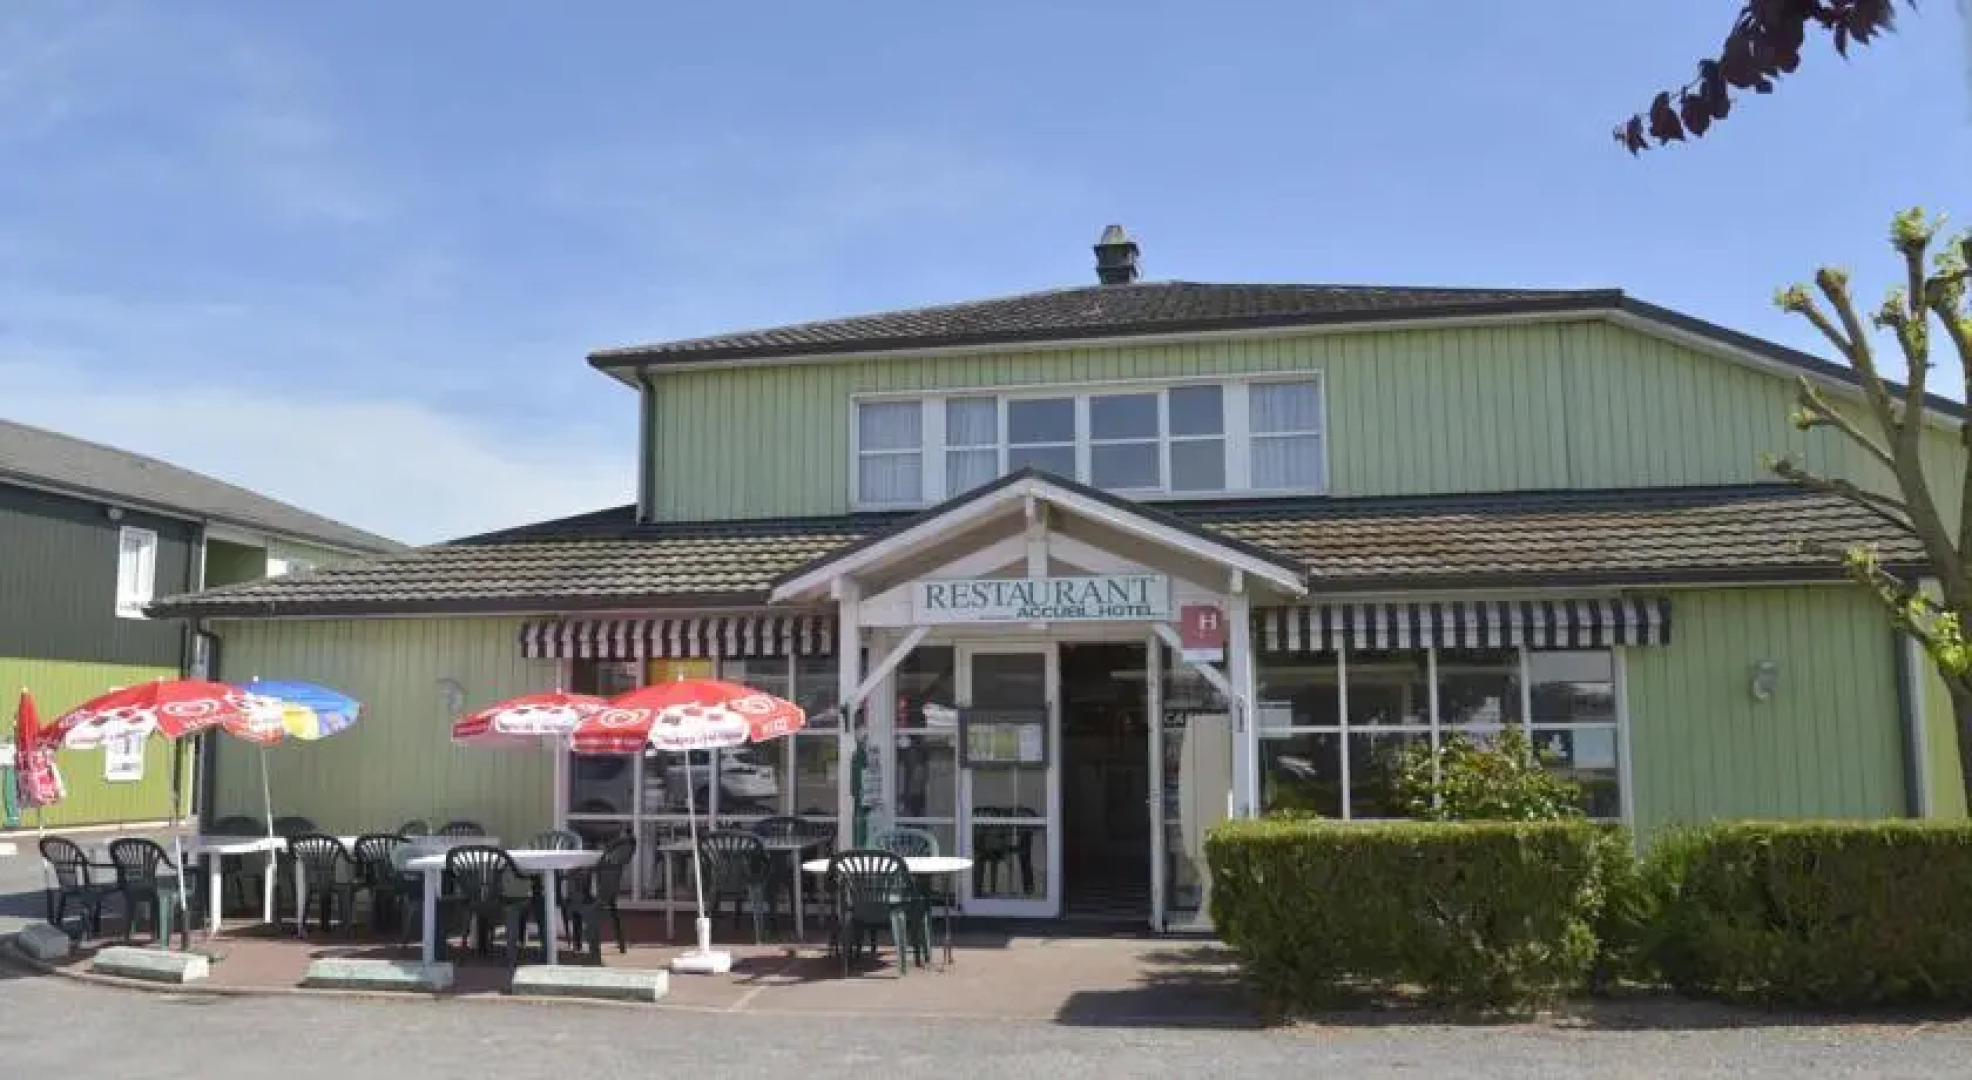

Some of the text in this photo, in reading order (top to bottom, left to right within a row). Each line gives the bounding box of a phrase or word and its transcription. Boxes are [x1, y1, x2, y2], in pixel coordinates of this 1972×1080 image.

[925, 578, 1156, 609] RESTAURANT
[1017, 604, 1151, 618] ACCUEIL HOTEL
[1199, 613, 1217, 630] H
